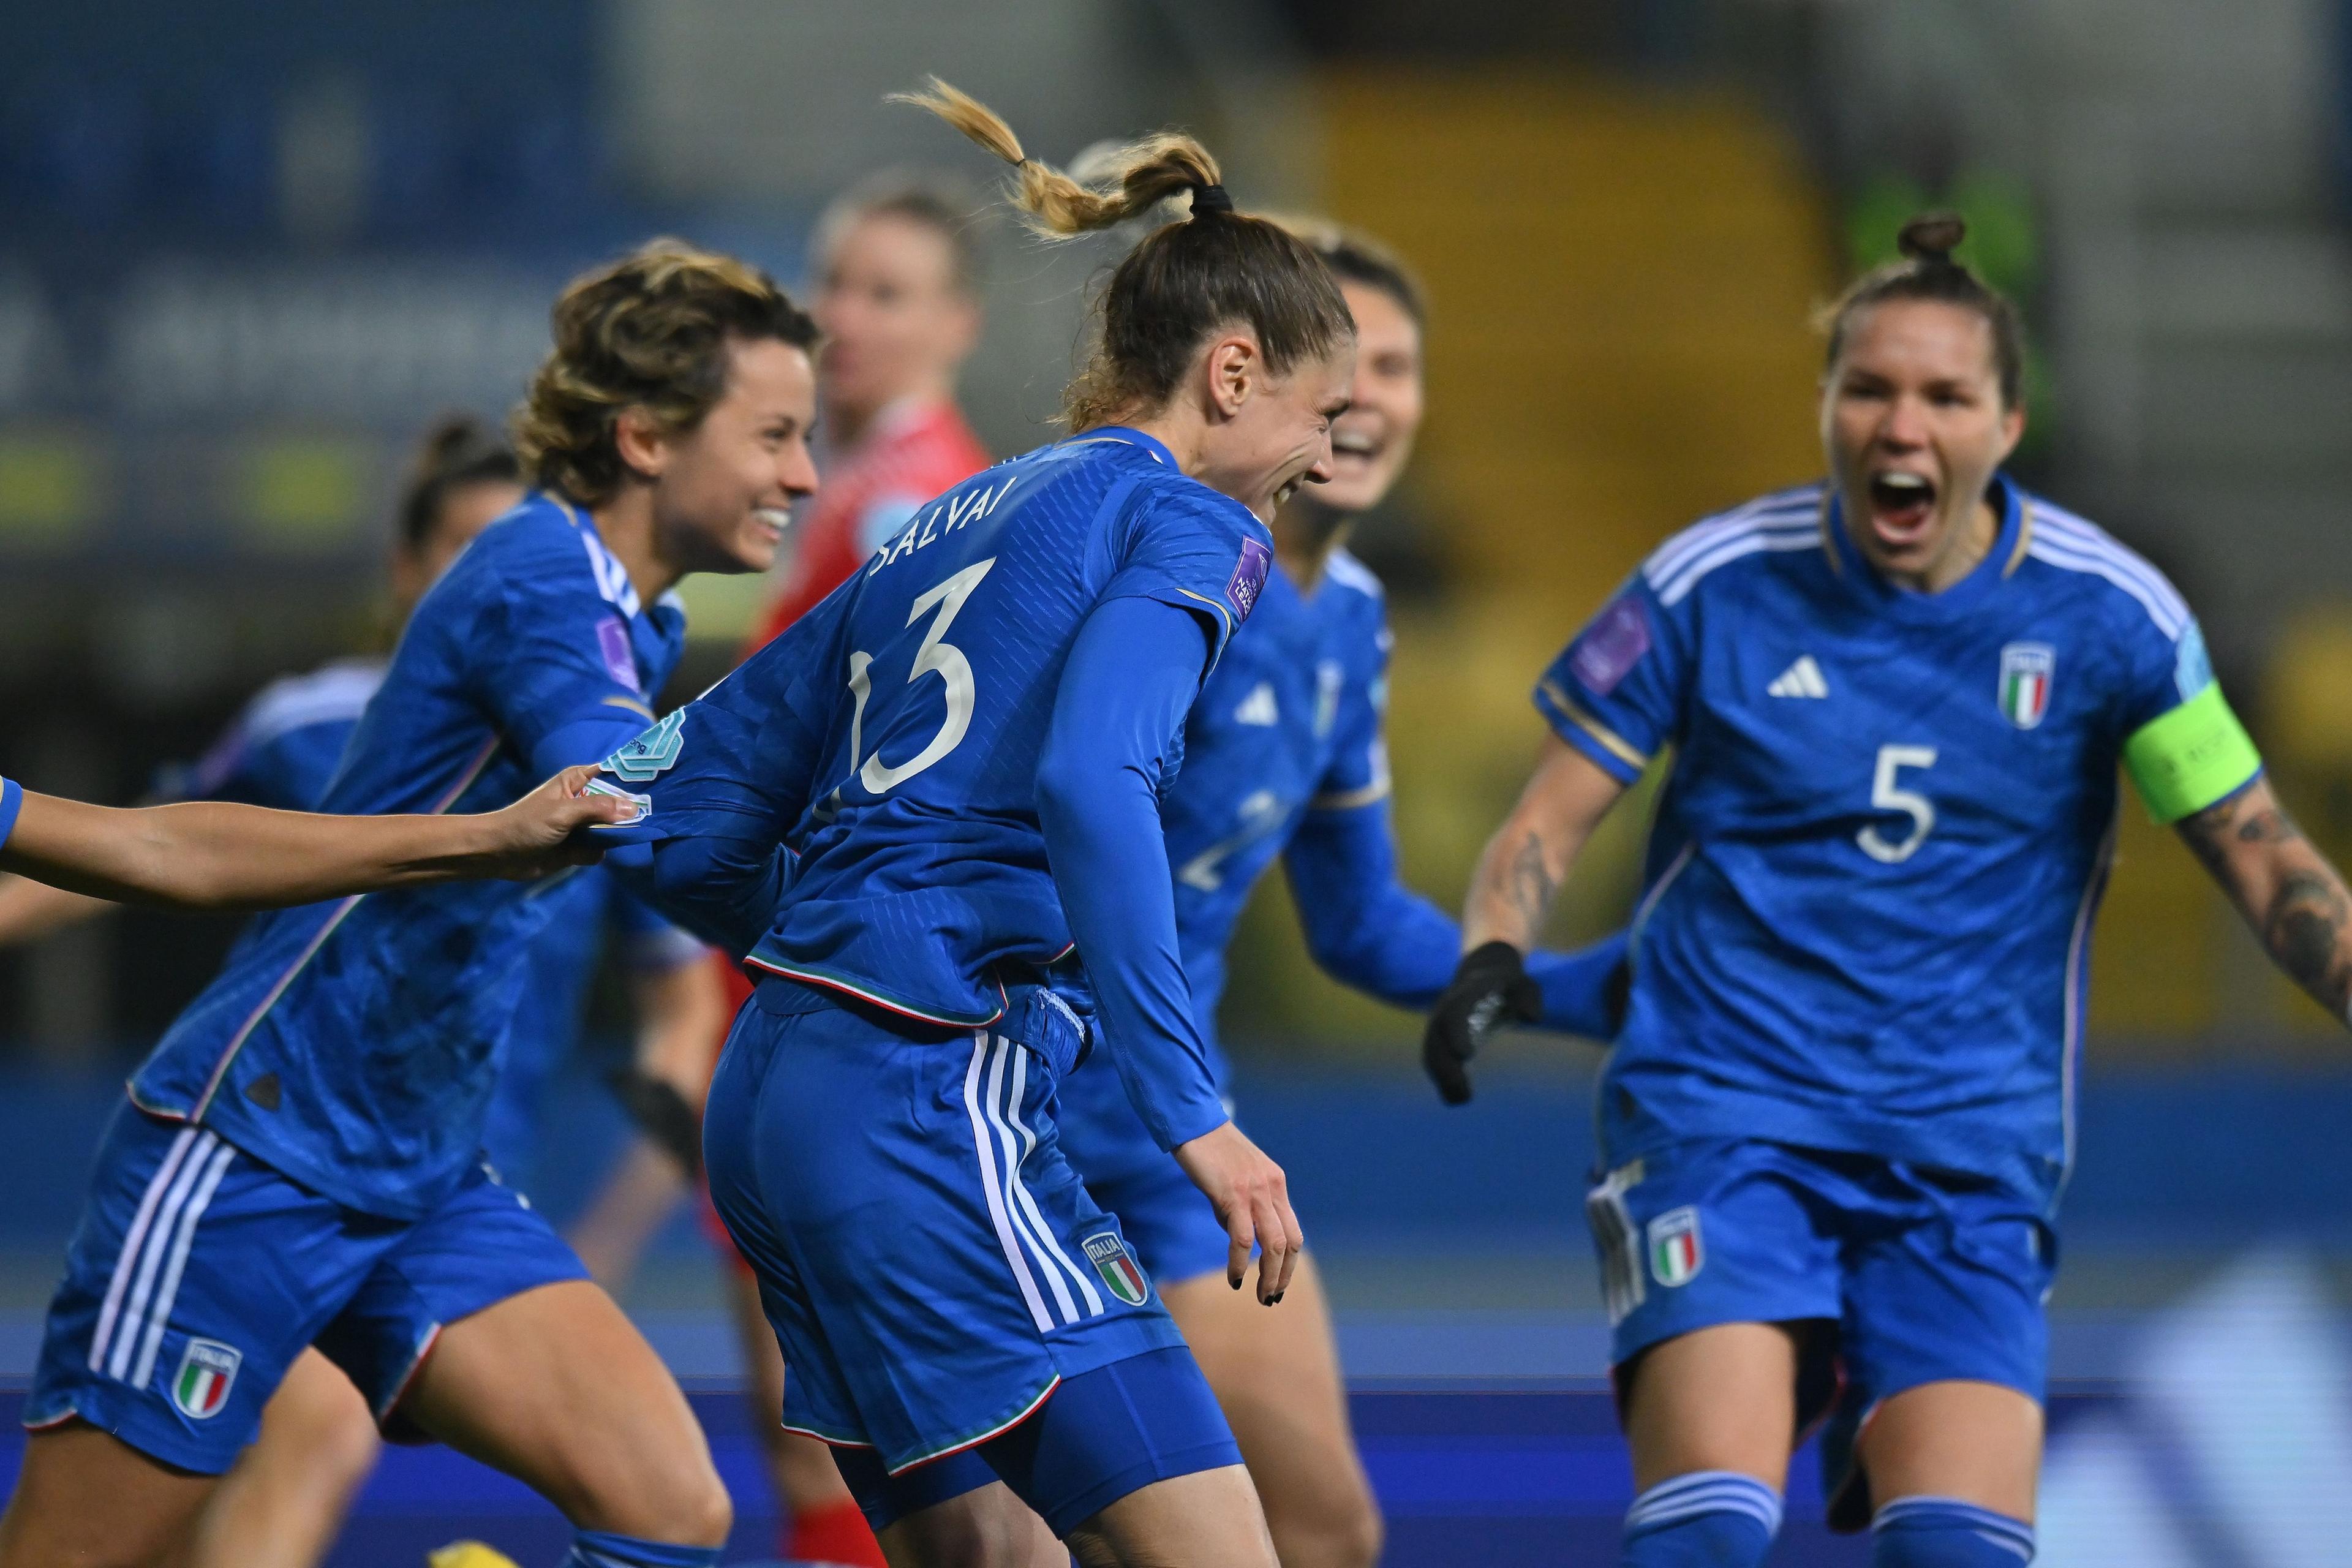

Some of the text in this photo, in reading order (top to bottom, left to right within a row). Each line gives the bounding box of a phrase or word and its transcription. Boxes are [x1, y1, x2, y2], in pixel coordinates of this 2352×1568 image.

[869, 476, 1017, 577] SALVAI
[1856, 745, 1938, 864] 5
[1087, 1238, 1120, 1259] ITALIA
